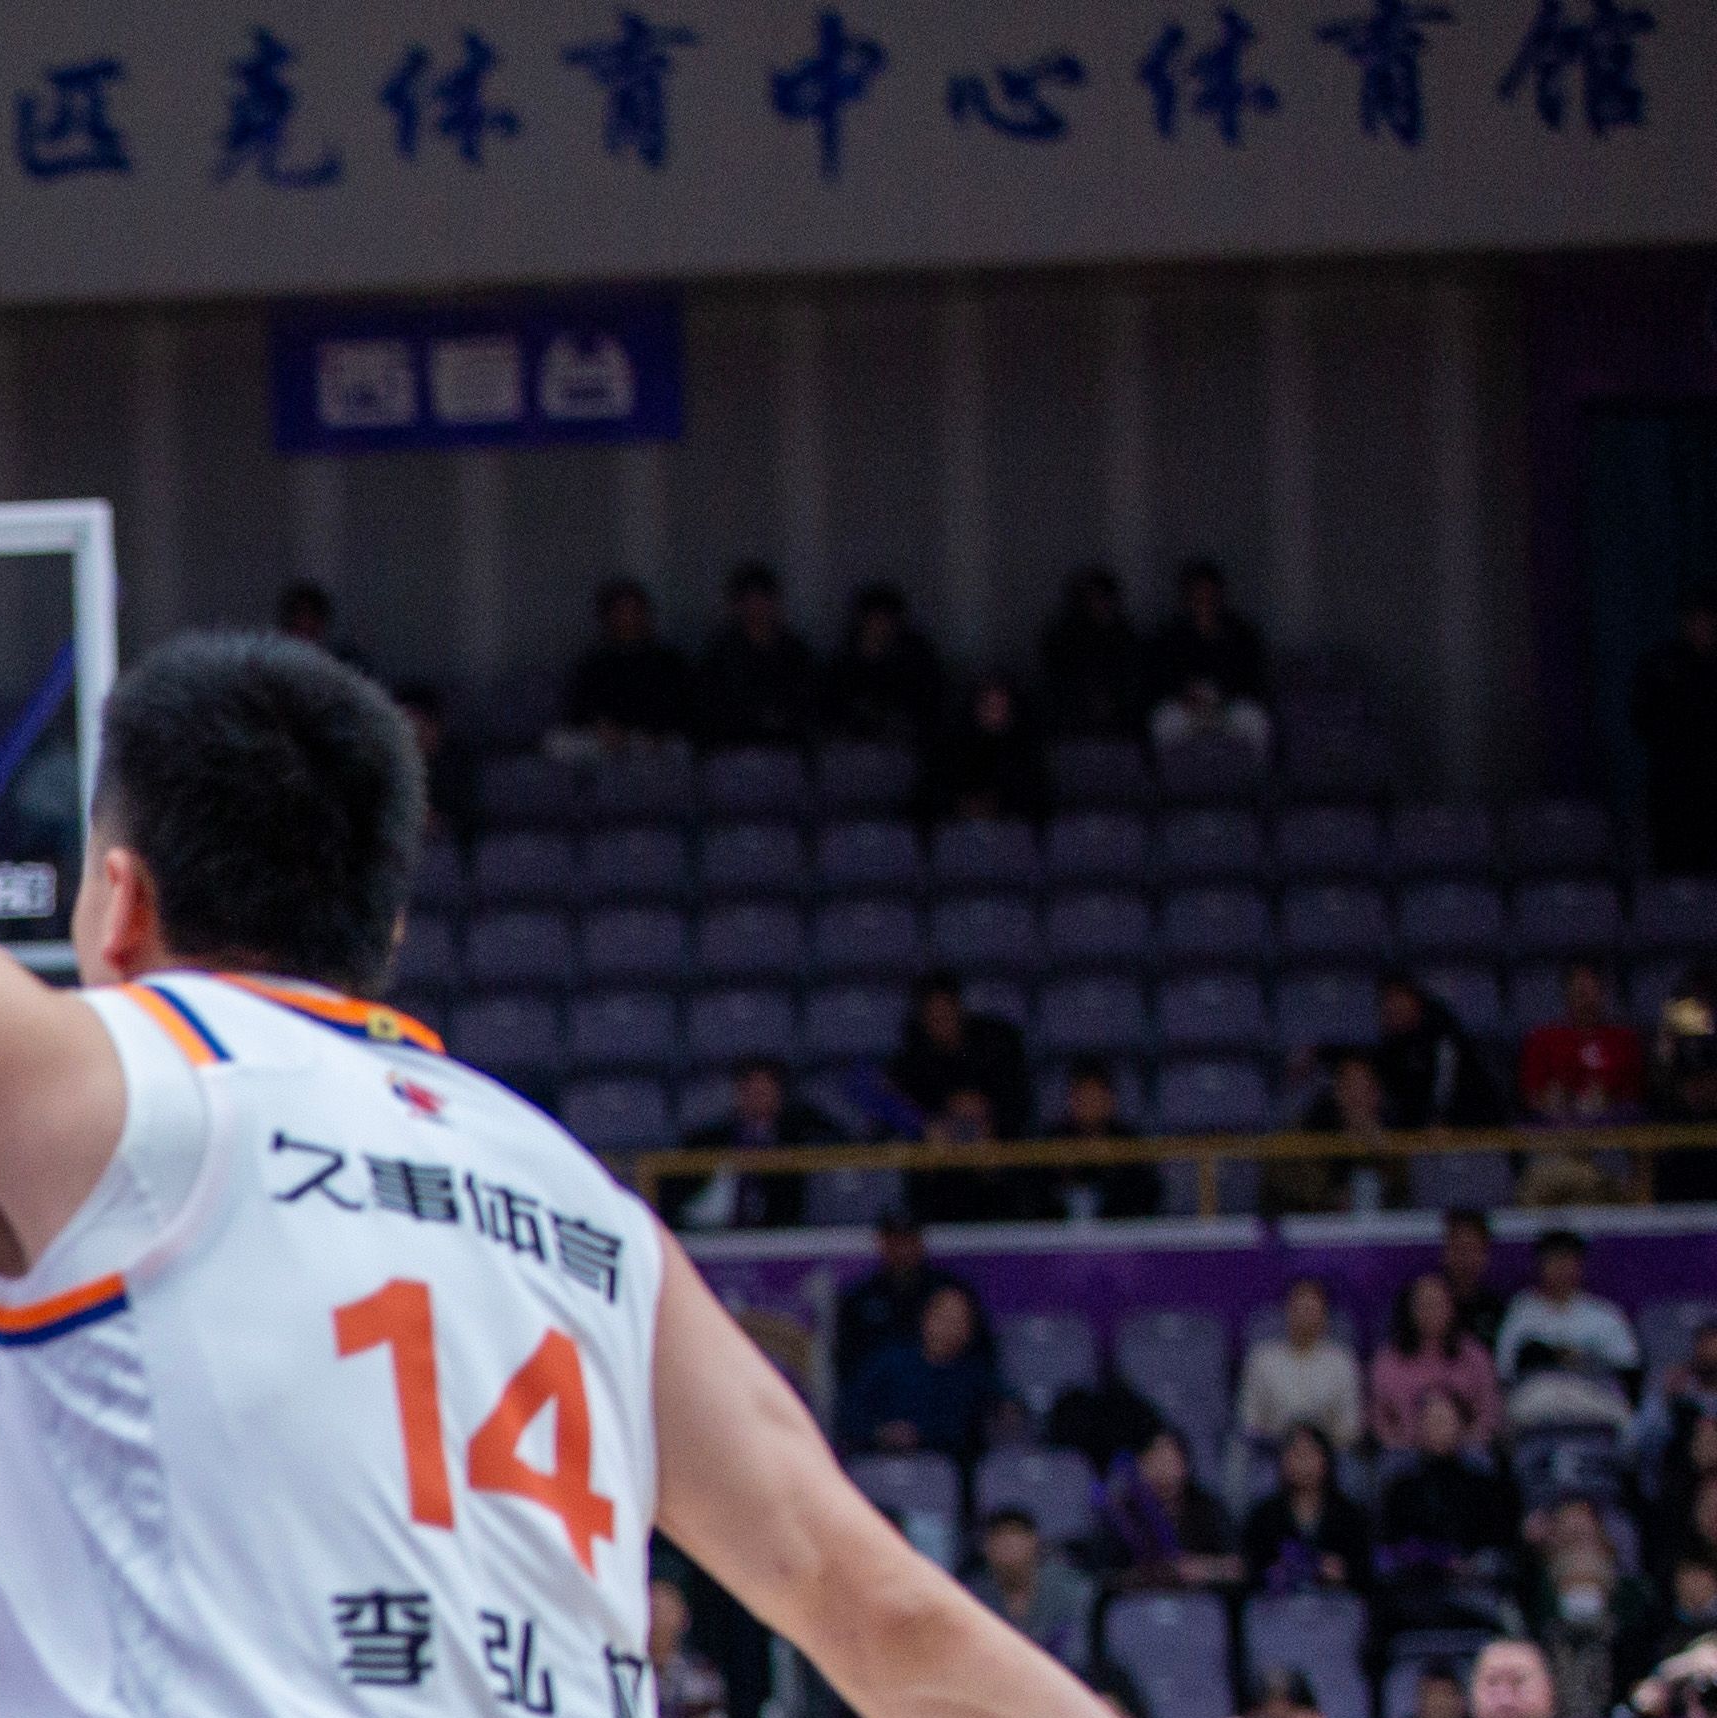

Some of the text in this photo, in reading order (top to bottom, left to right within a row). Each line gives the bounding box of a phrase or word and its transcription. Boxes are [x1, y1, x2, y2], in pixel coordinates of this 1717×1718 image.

[271, 1131, 623, 1304] 久事体育
[332, 1276, 615, 1580] 14
